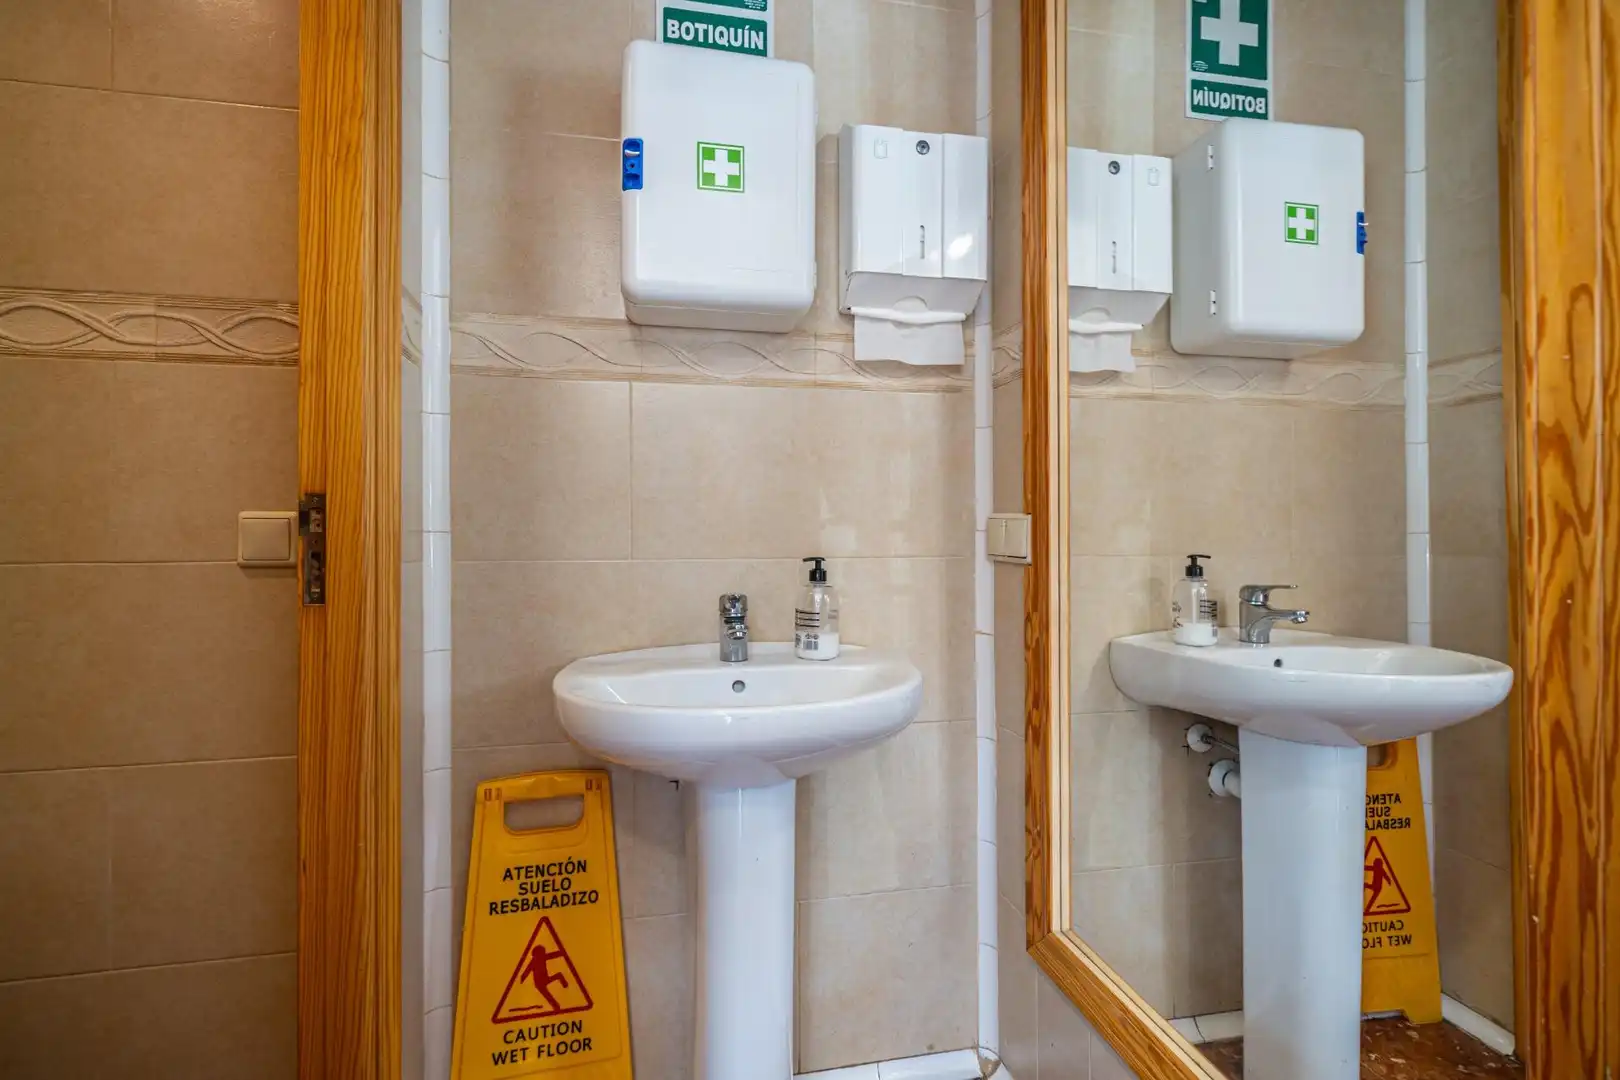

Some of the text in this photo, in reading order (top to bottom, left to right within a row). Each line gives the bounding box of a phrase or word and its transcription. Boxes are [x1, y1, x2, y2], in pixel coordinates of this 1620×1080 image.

[666, 18, 764, 50] BOTIQUÍN
[502, 856, 587, 882] ATENCIÓN
[518, 877, 572, 896] SUELO
[489, 889, 599, 916] RESBALADIZO
[503, 1019, 583, 1044] CAUTION
[491, 1037, 592, 1066] WET FLOOR
